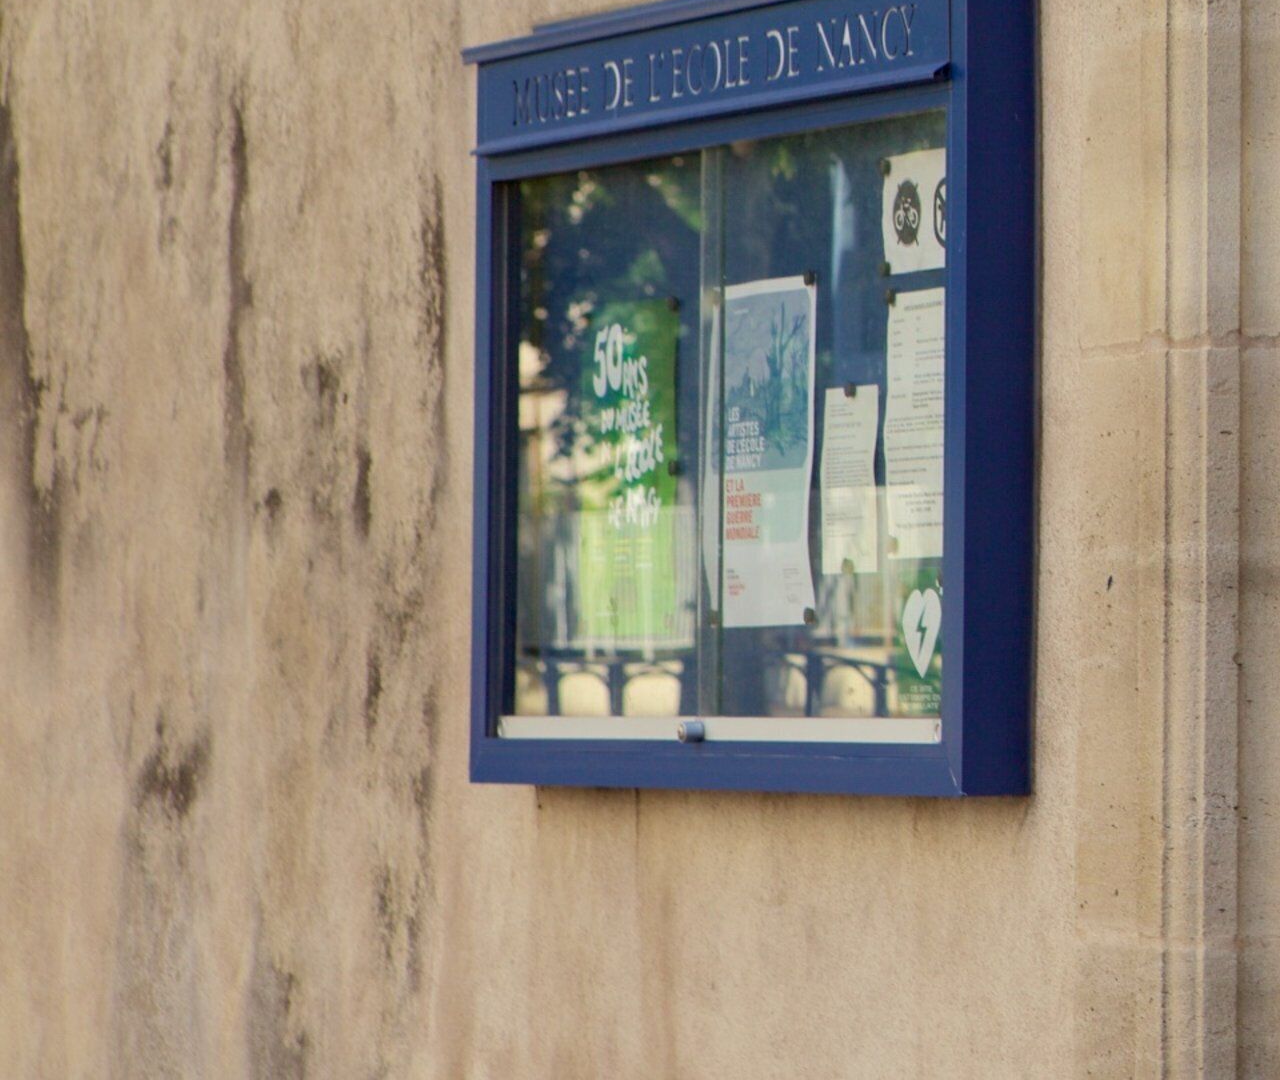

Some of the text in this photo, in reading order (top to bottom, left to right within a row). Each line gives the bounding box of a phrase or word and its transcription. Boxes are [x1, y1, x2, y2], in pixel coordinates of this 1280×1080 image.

[512, 67, 590, 126] MUSEE
[603, 58, 634, 111] DE
[766, 26, 799, 81] DE
[816, 3, 916, 72] NANCY
[593, 324, 623, 398] 50
